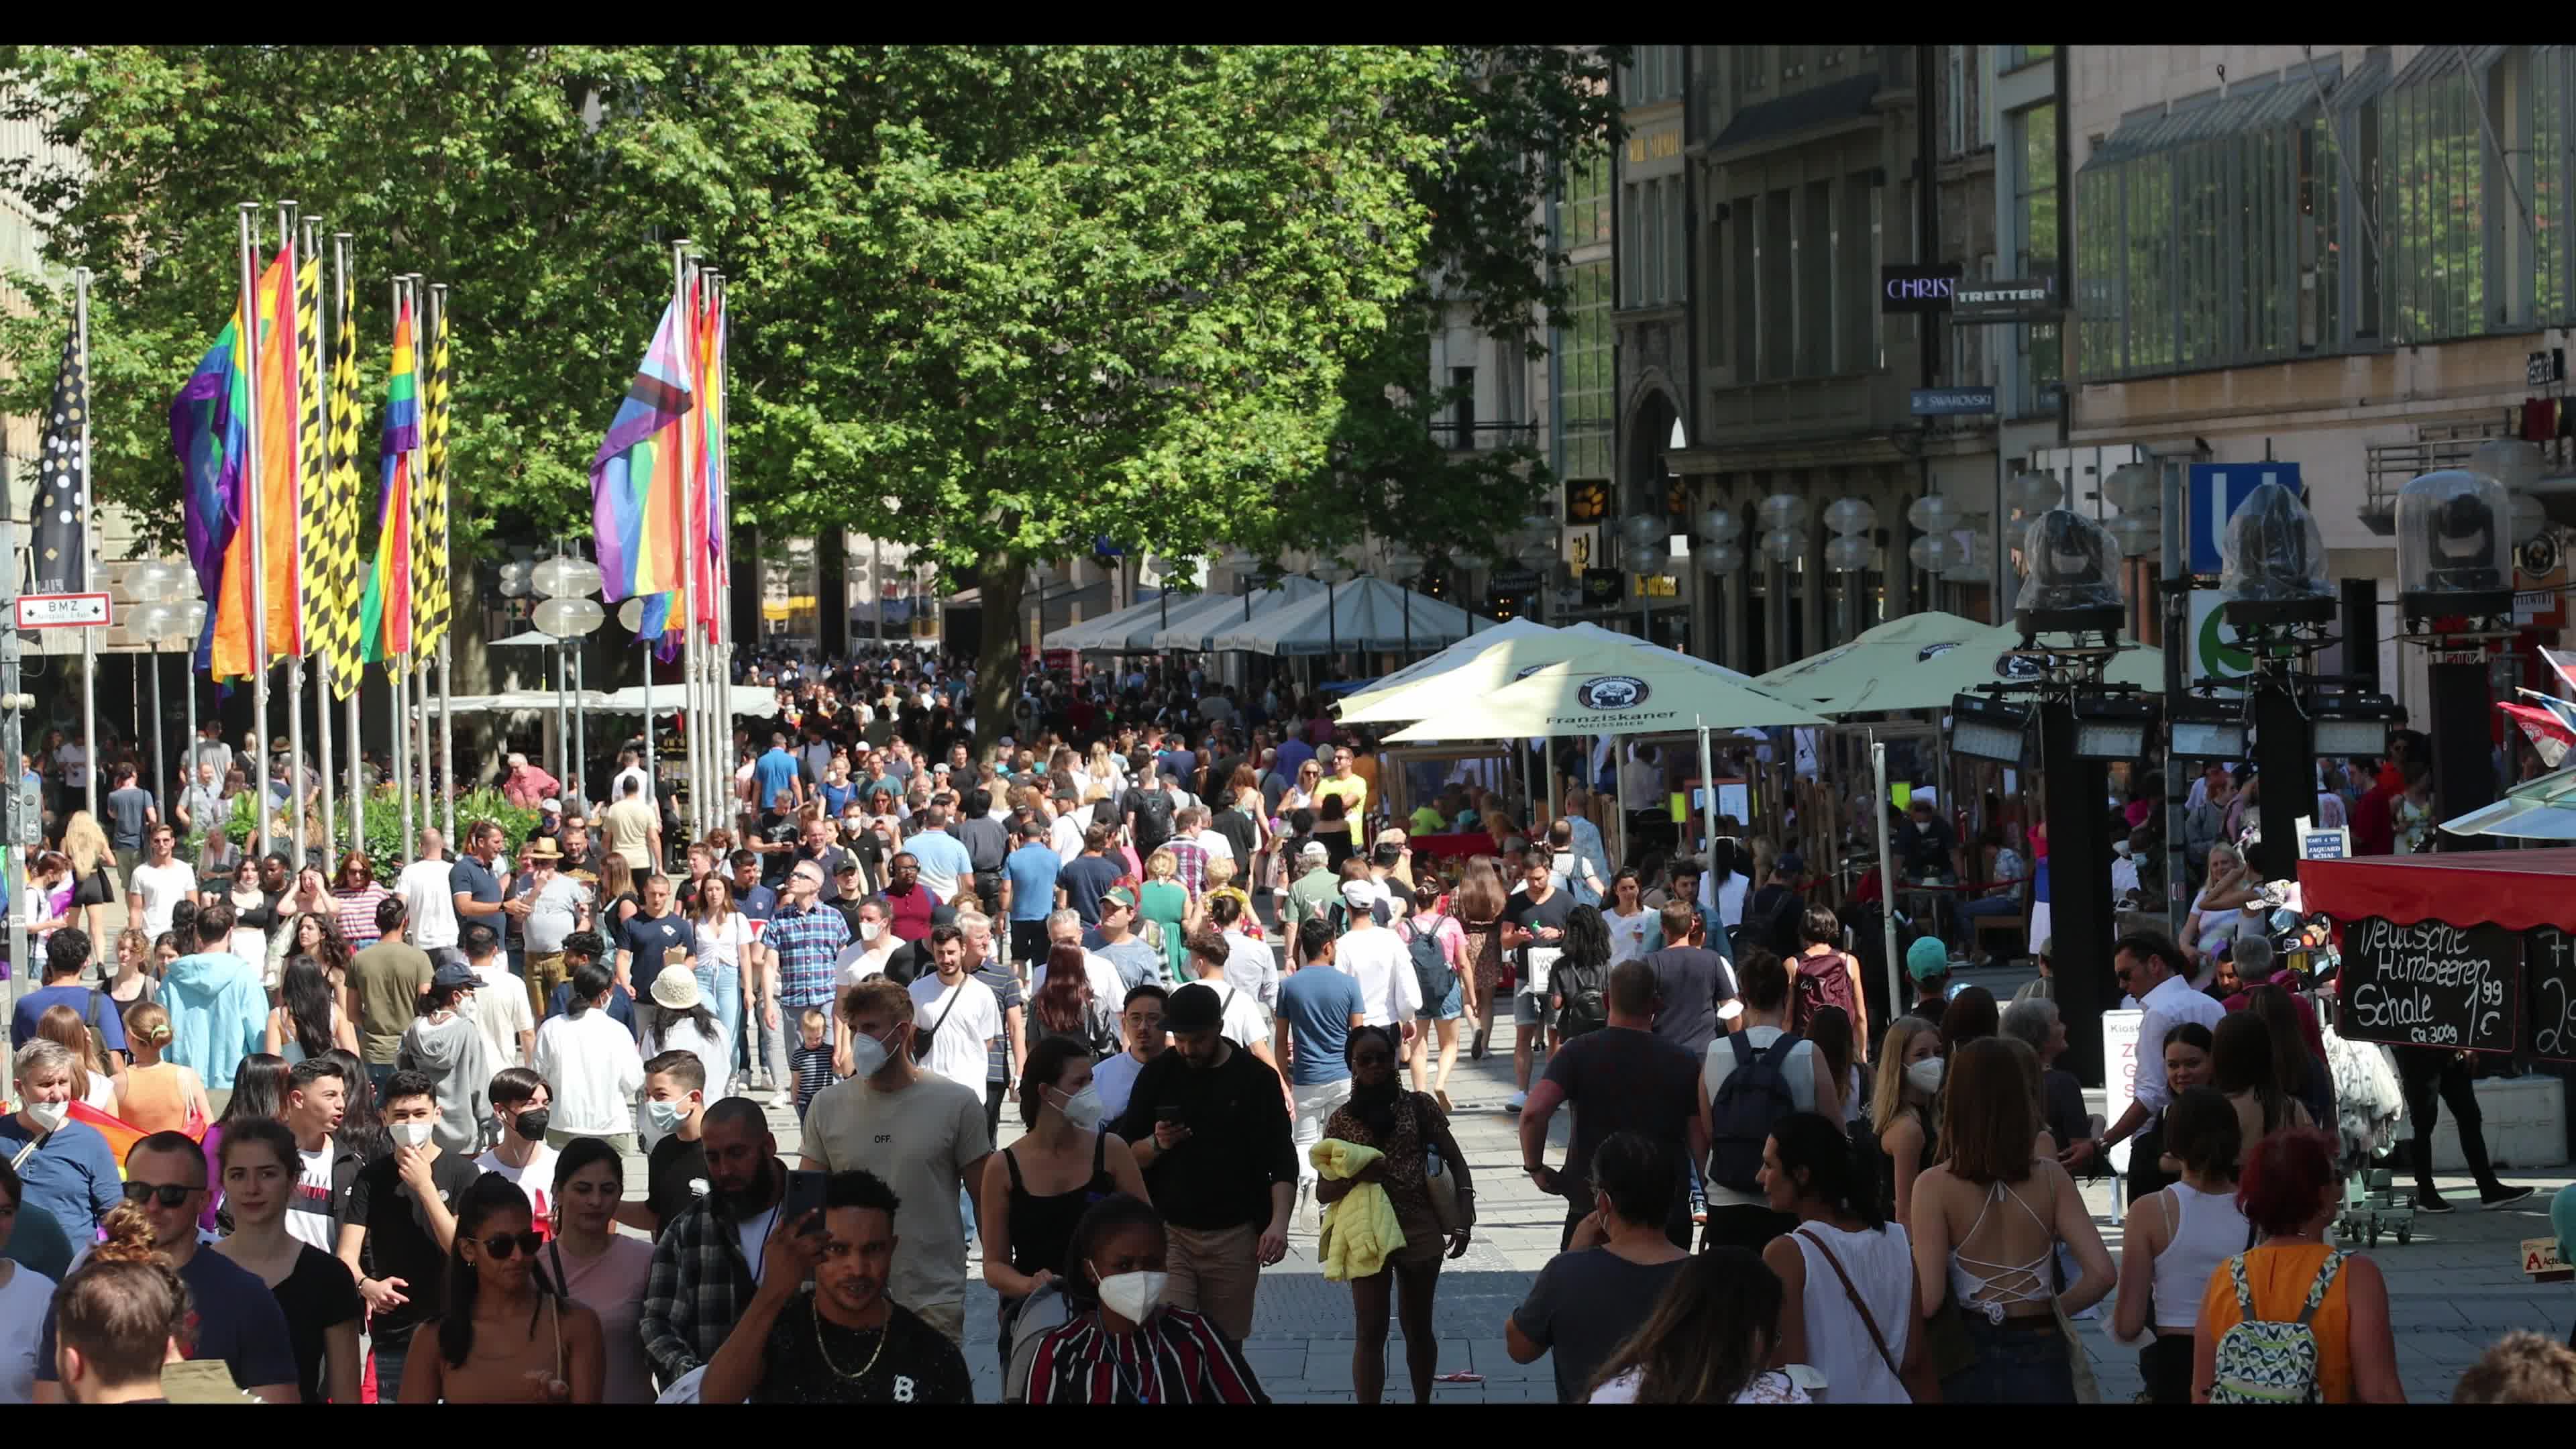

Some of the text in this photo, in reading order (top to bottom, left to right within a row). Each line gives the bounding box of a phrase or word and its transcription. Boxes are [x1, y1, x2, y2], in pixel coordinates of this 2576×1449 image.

[1957, 289, 2045, 302] TRETTER
[48, 600, 78, 612] BMZ
[1546, 710, 1679, 724] Franziskaner
[1576, 720, 1645, 729] WEISSBIER
[2377, 949, 2490, 987] Himbeeren
[2354, 983, 2435, 1027] Schale
[893, 1374, 914, 1403] B
